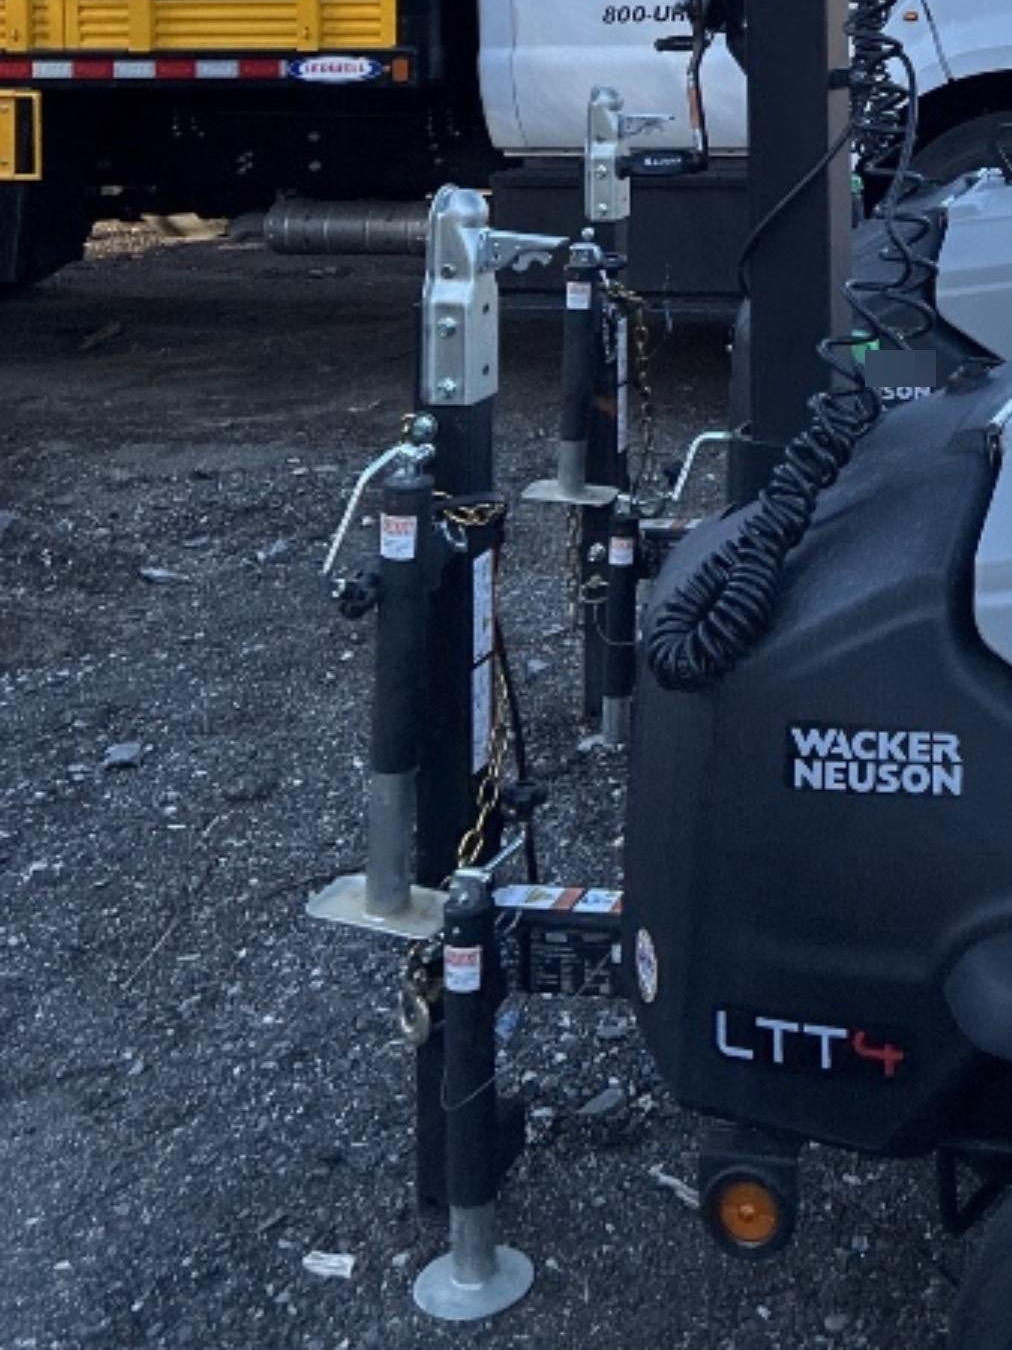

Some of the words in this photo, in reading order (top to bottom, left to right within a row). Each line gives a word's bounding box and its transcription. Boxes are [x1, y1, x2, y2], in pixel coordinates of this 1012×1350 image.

[791, 727, 963, 763] WACKER
[794, 759, 962, 796] NEUSON
[716, 1010, 904, 1077] LTT4
